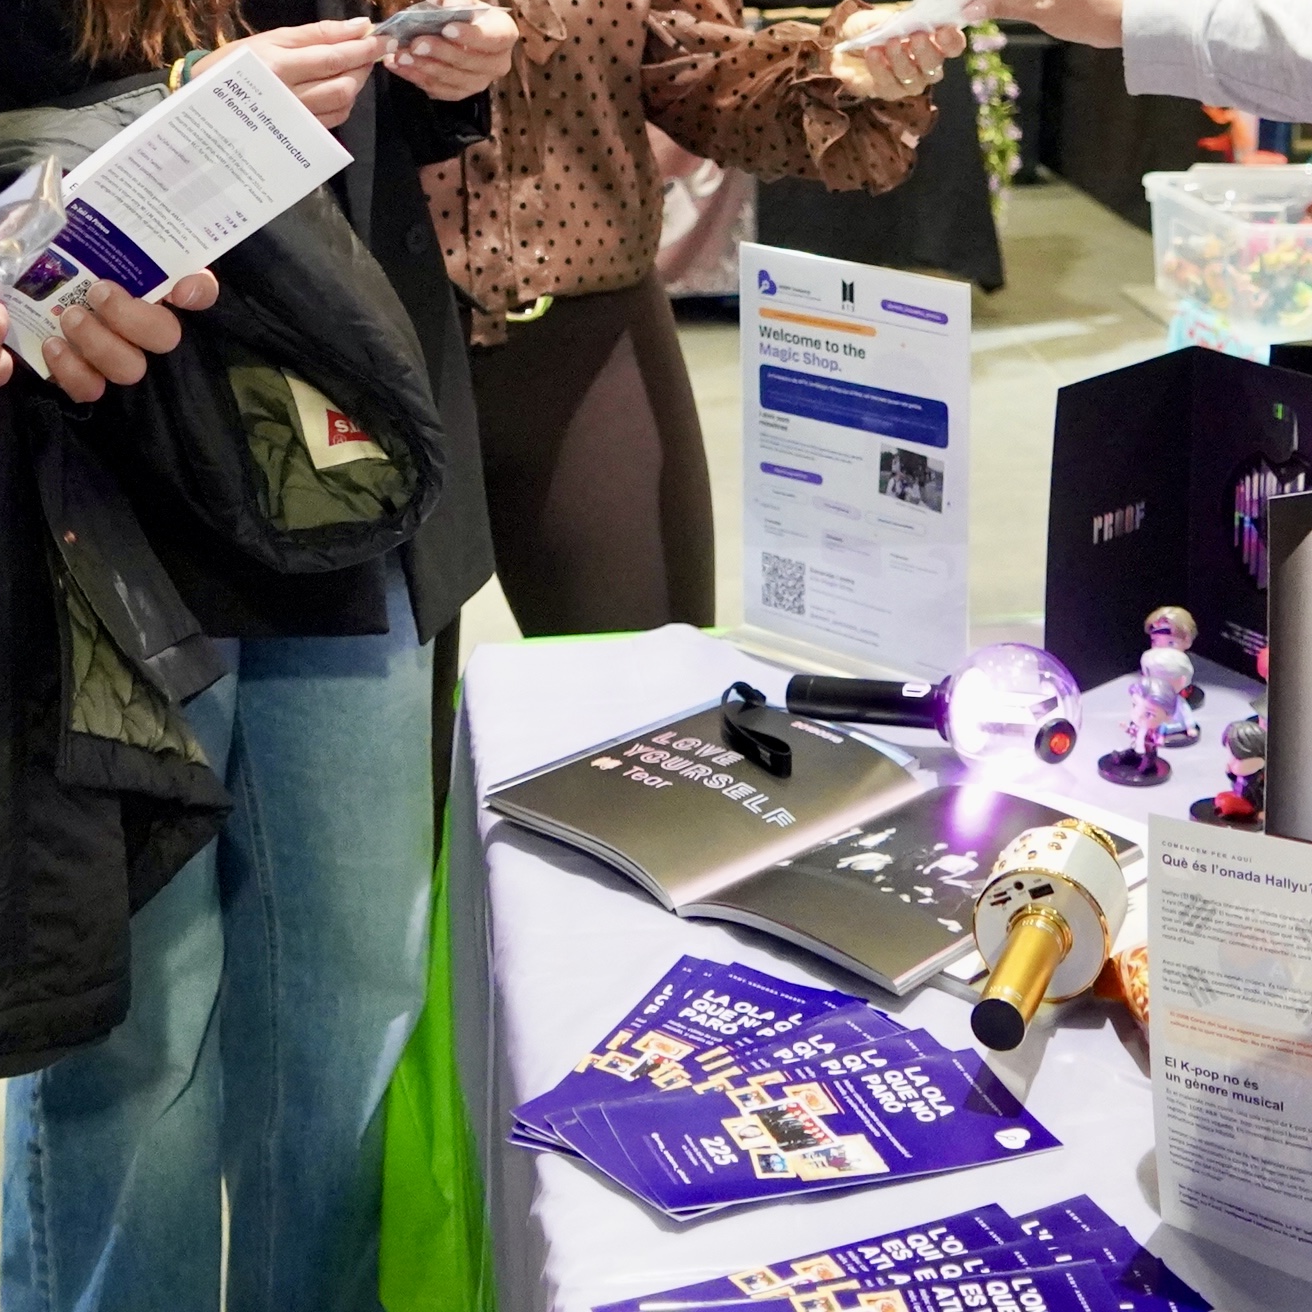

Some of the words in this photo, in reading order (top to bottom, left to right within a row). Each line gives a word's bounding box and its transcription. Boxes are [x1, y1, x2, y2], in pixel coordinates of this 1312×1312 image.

[211, 85, 228, 100] del
[223, 76, 252, 105] ARMY:
[248, 102, 261, 112] la
[255, 110, 313, 169] infraestructura
[759, 325, 821, 349] Welcome
[826, 340, 839, 353] to
[843, 344, 865, 359] the
[759, 343, 799, 362] Magic
[804, 353, 841, 372] Shop.
[652, 732, 744, 767] LOVE
[623, 765, 673, 789] Tear
[623, 743, 796, 828] YOURSELF
[1162, 852, 1188, 869] Què
[1192, 858, 1206, 873] és
[692, 999, 737, 1022] QUE
[738, 1017, 761, 1028] N
[703, 989, 730, 1007] LA
[734, 1002, 775, 1020] OLA
[678, 1008, 739, 1034] PARÓ
[1164, 1054, 1176, 1068] El
[1180, 1059, 1218, 1083] K-pop
[1223, 1073, 1239, 1087] no
[1243, 1077, 1258, 1091] és
[860, 1074, 904, 1115] PARÓ
[884, 1070, 917, 1100] QUE
[913, 1098, 936, 1123] NO
[903, 1066, 930, 1086] LA
[921, 1085, 956, 1117] OLA
[1165, 1070, 1180, 1083] un
[1185, 1073, 1227, 1101] gènere
[1232, 1086, 1283, 1115] musical
[700, 1136, 738, 1165] 225
[882, 1240, 913, 1261] ES
[959, 1283, 987, 1307] ES
